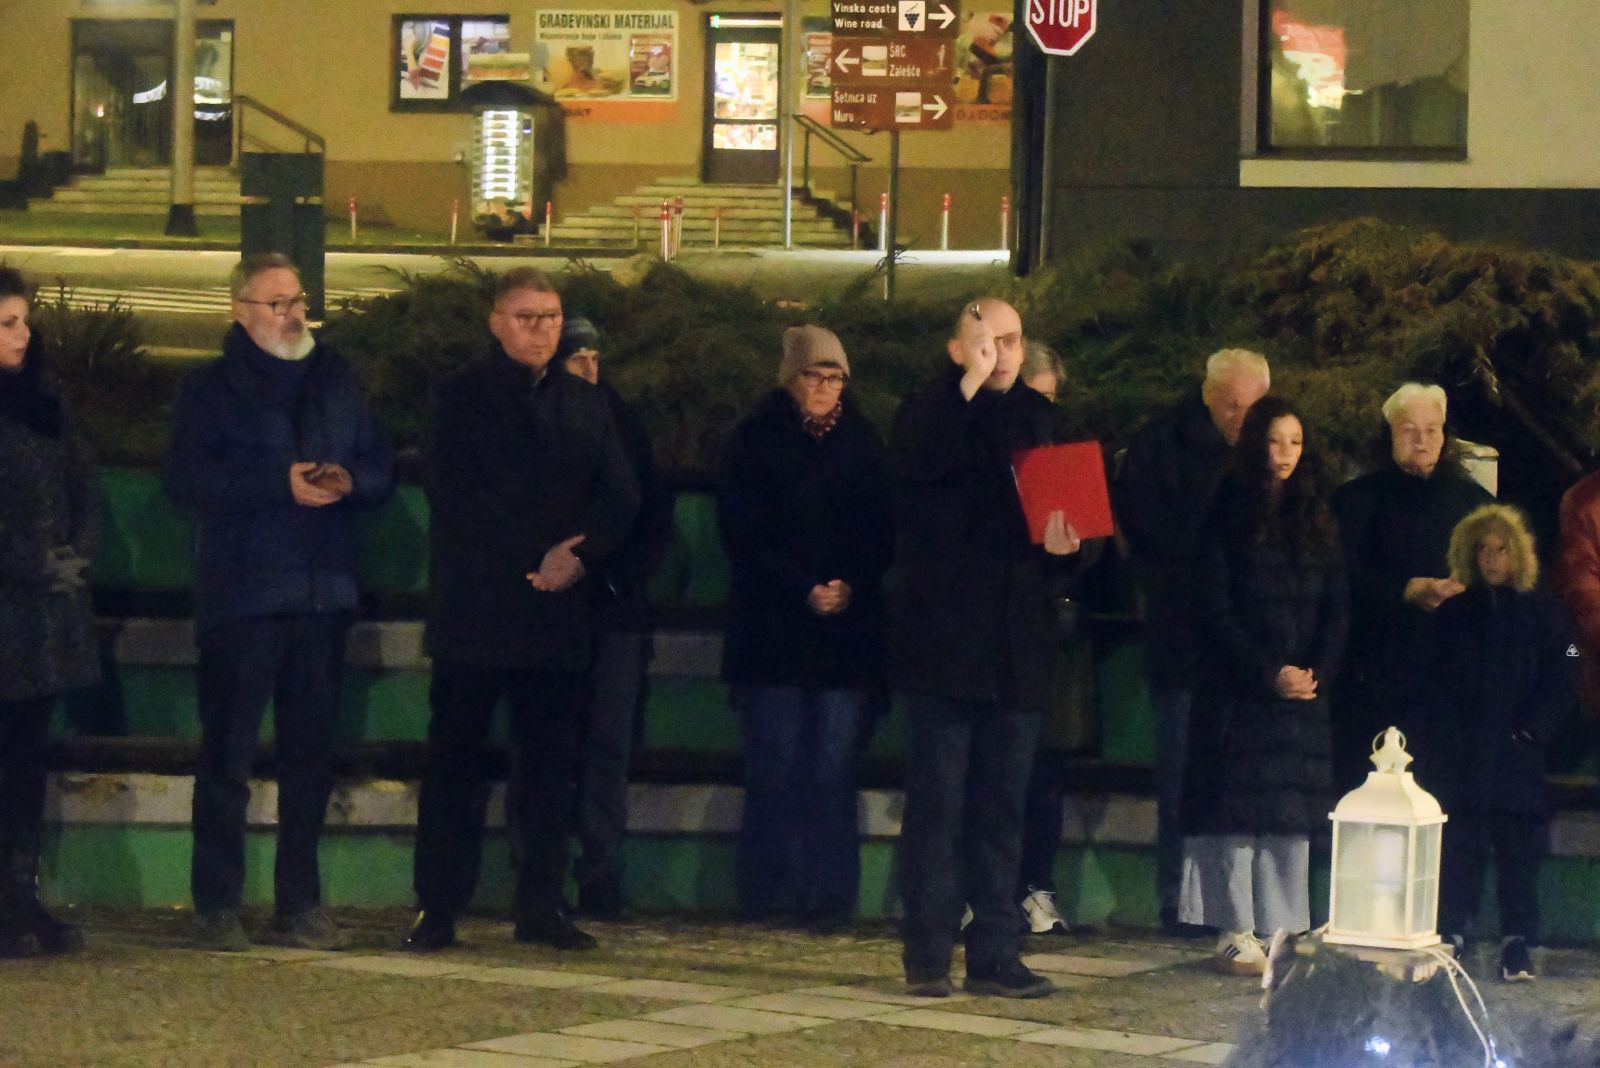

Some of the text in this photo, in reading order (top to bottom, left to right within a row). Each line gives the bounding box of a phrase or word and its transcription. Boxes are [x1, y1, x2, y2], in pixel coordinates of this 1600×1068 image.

[833, 3, 897, 13] Vinska cesta
[1031, 0, 1090, 28] STOP
[614, 13, 674, 29] MATERIJAL
[834, 18, 883, 28] Wine road
[867, 93, 878, 103] uz
[833, 110, 854, 122] Muru
